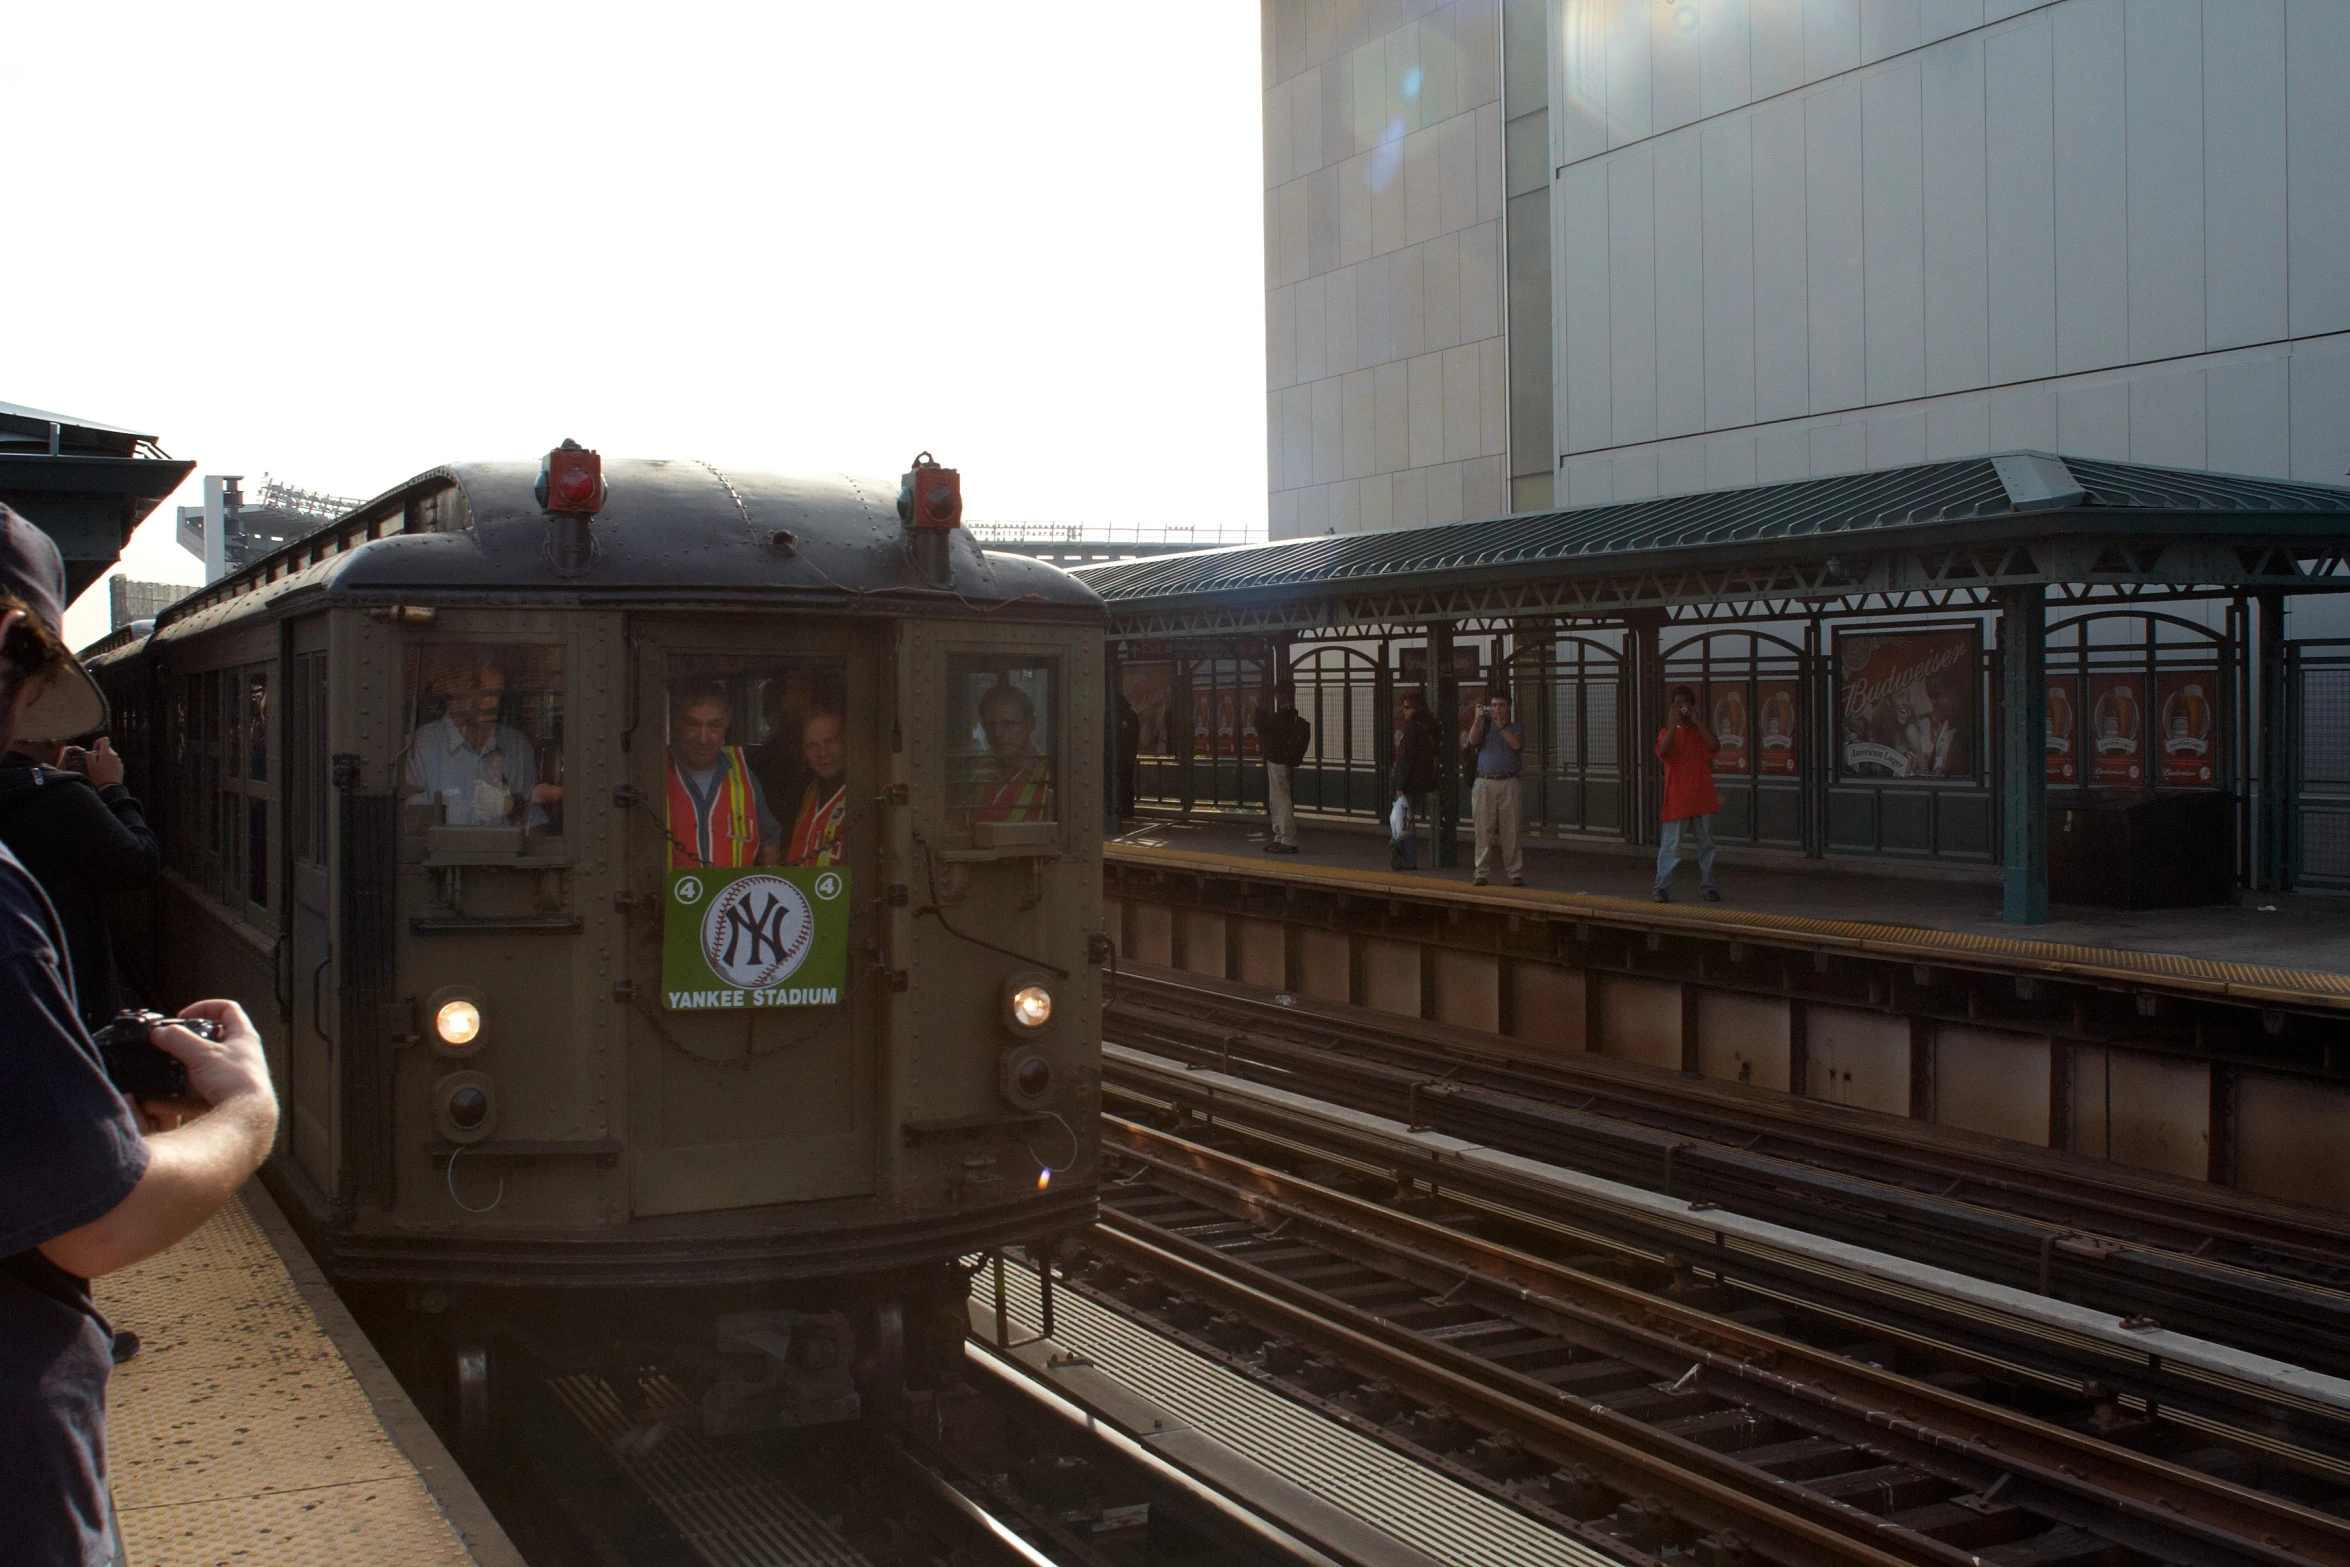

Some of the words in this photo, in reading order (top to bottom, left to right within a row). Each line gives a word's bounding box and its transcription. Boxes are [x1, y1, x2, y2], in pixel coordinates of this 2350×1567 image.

[1841, 641, 1966, 718] Budweiser
[1850, 748, 1884, 758] American
[1884, 753, 1904, 769] Lager
[680, 882, 695, 898] 4
[820, 878, 835, 894] 4
[722, 891, 790, 968] NY
[669, 990, 744, 1008] YANKEE
[753, 988, 837, 1006] STADIUM
